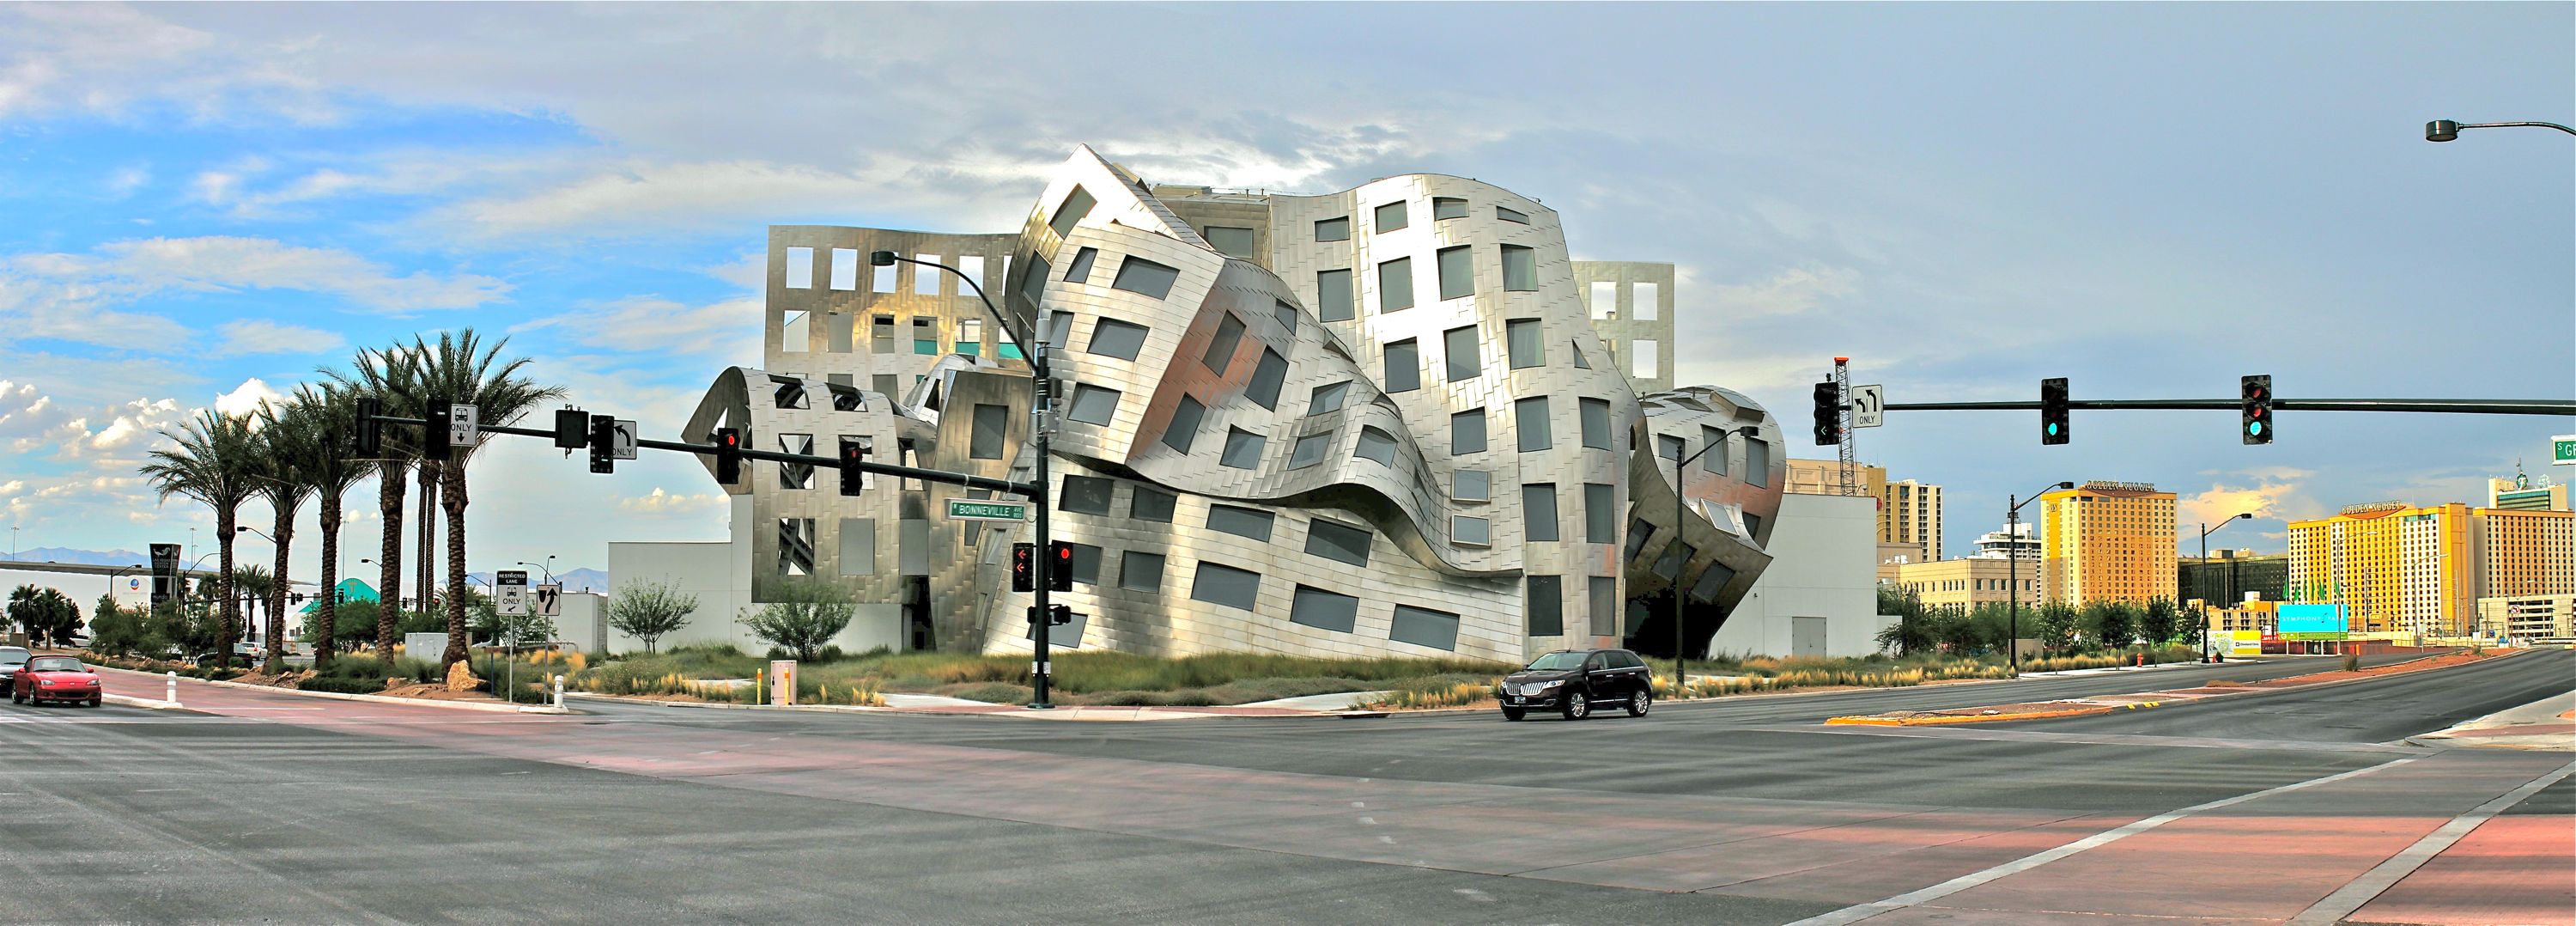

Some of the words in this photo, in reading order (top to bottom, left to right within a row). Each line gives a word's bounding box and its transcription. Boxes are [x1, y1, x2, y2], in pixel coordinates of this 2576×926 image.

[1859, 415, 1875, 424] ONLY
[2557, 442, 2563, 451] S
[2087, 480, 2119, 490] GOLDEN
[2121, 481, 2156, 491] NUGGET
[959, 505, 1010, 516] BONNEVILLE
[2342, 504, 2369, 515] GOLDEN
[2372, 501, 2400, 511] NUGGET
